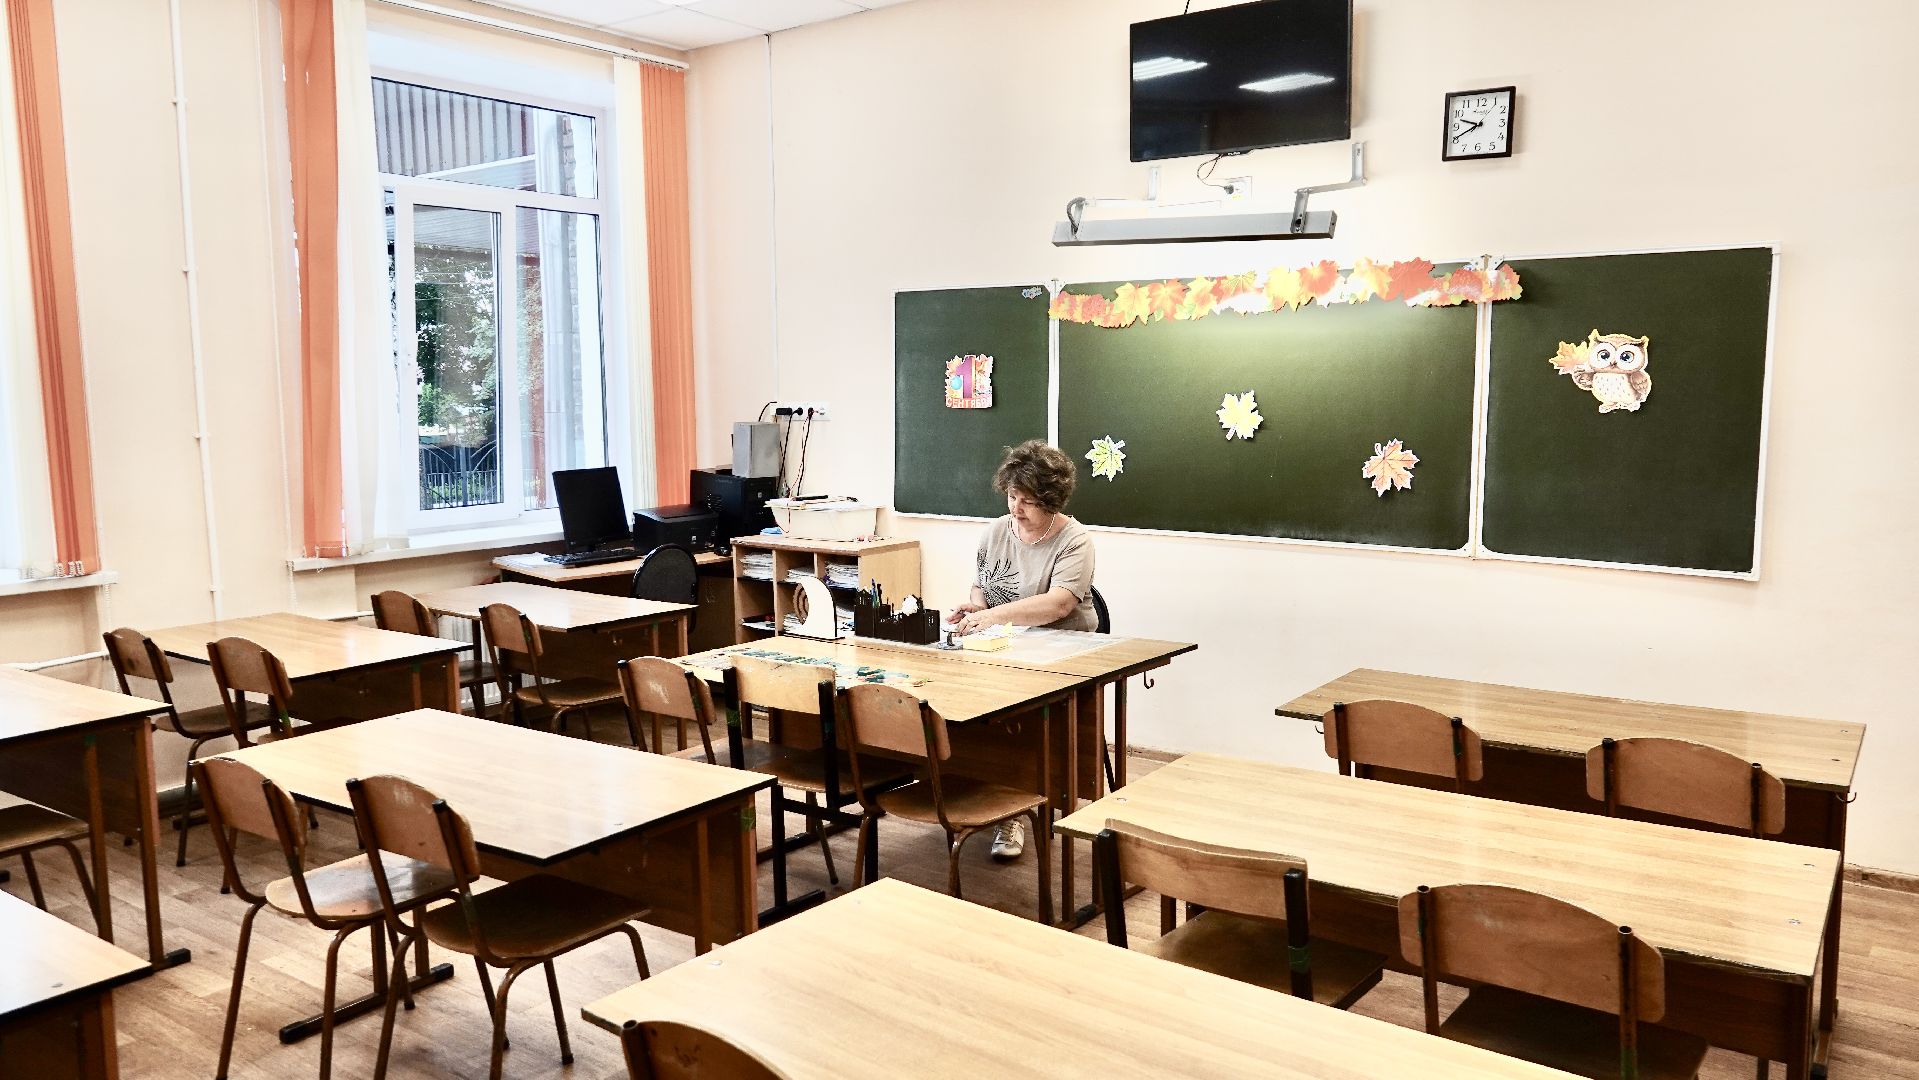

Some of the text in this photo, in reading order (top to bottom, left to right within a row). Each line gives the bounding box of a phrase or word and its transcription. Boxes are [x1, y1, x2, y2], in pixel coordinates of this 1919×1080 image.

[1462, 100, 1470, 108] 11
[1477, 98, 1487, 107] 12
[1455, 109, 1464, 118] 10
[1500, 105, 1506, 114] 2
[1453, 122, 1460, 131] 9
[1499, 118, 1506, 127] 3
[1452, 136, 1459, 144] 8
[1497, 132, 1504, 140] 4
[1462, 144, 1467, 152] 7
[1474, 143, 1481, 151] 6
[1488, 141, 1496, 151] 5
[956, 355, 976, 399] 1
[946, 398, 991, 408] СЕНТЯБР
